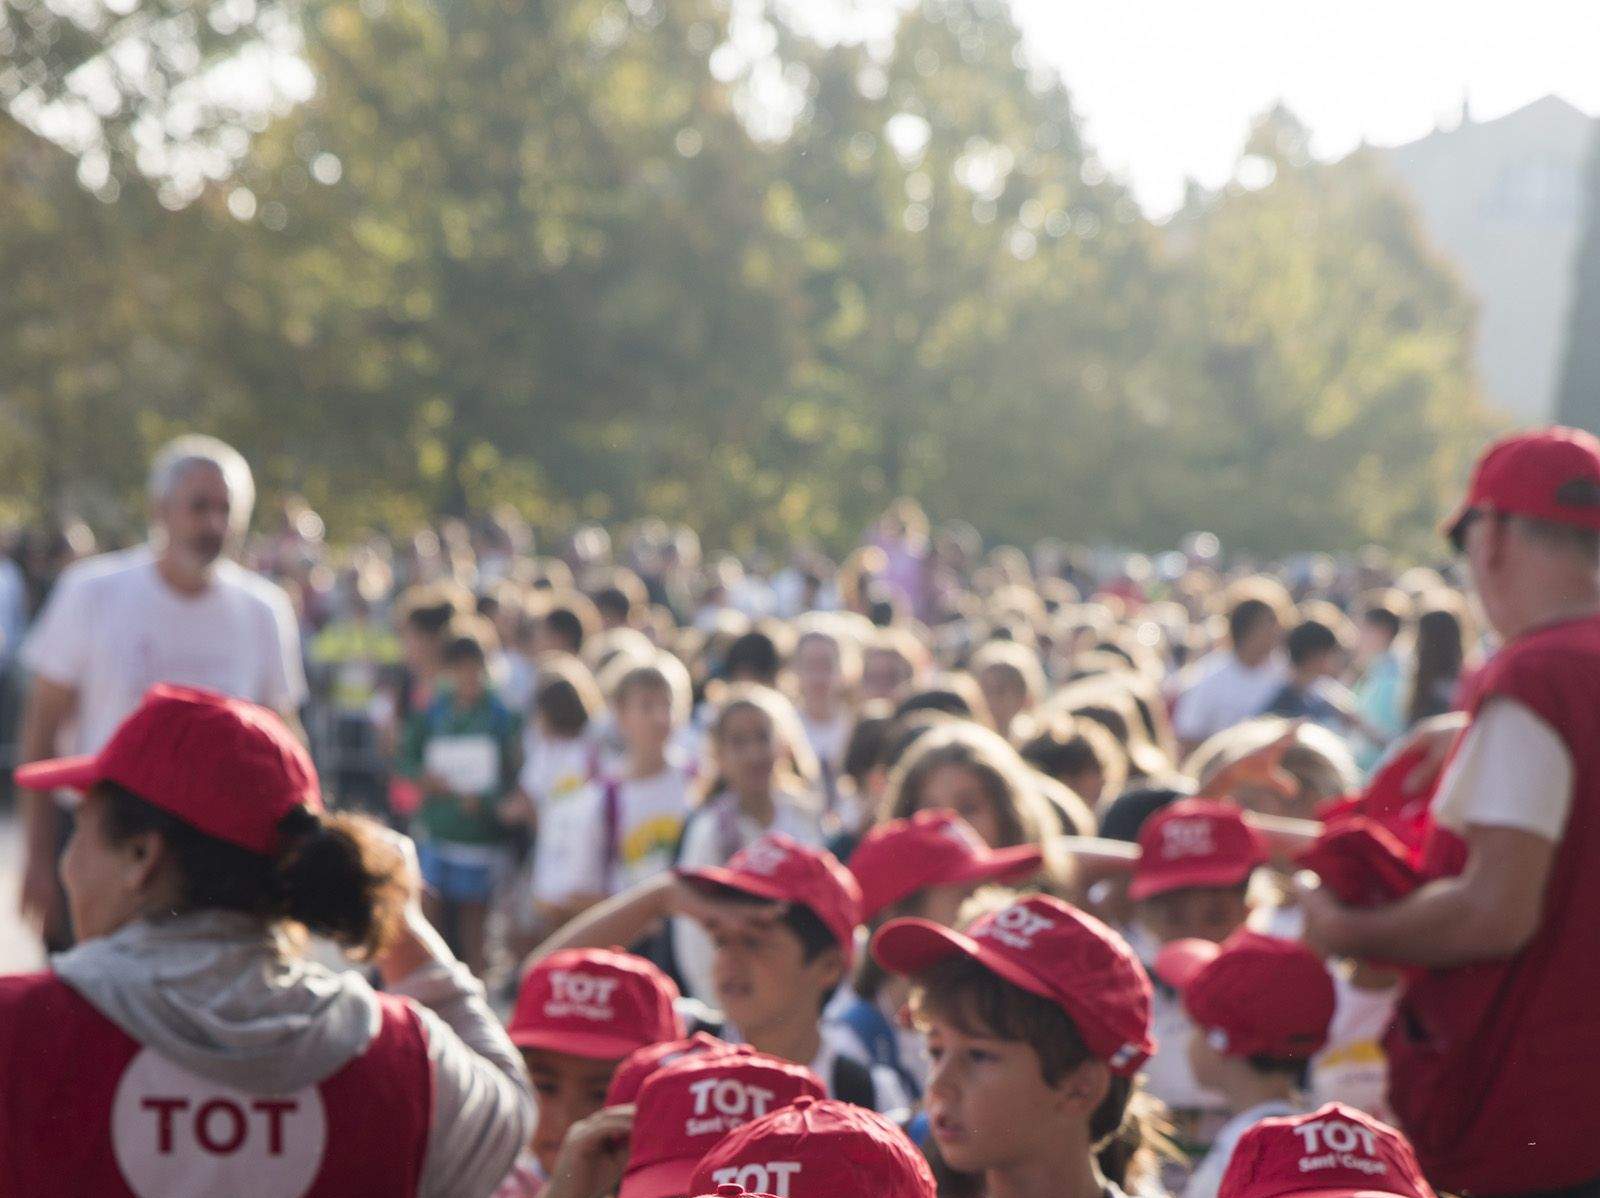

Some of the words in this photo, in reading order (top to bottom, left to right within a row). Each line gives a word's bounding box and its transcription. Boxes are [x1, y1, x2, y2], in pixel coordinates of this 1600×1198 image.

[688, 1079, 775, 1117] TOT
[141, 1097, 298, 1154] TOT
[1293, 1120, 1375, 1157] TOT
